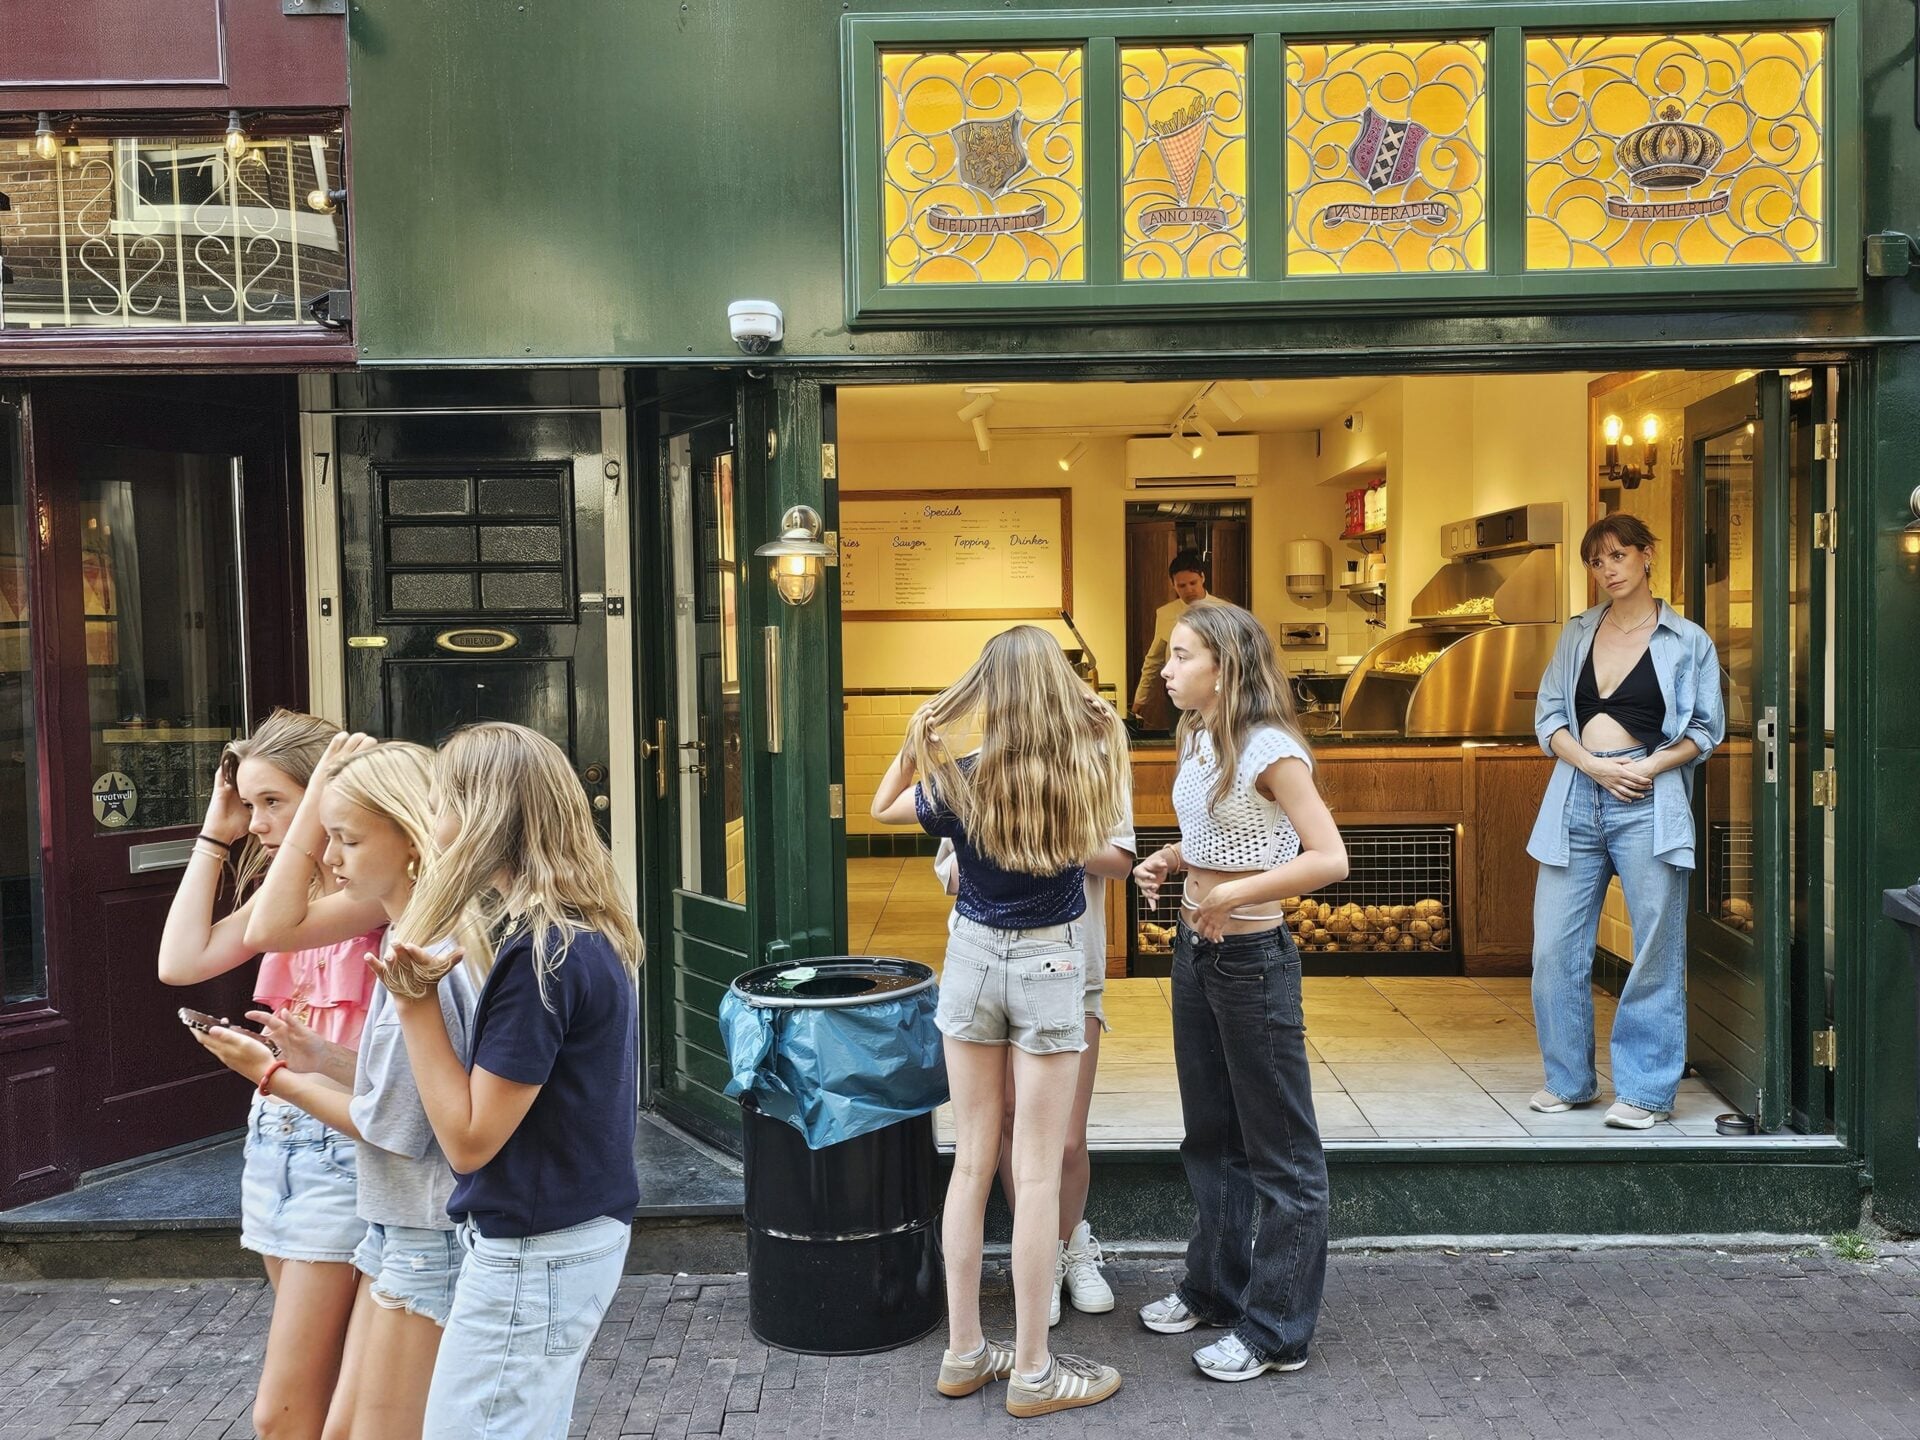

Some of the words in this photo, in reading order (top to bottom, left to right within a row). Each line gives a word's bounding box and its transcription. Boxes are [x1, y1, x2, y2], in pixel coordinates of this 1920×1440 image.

[1334, 202, 1440, 221] VASTBERADEN
[1620, 199, 1725, 218] BARMHARTIG
[1150, 209, 1188, 225] ANNO
[1192, 209, 1217, 222] 1924
[312, 452, 330, 485] 7
[604, 460, 620, 496] 9
[923, 505, 962, 518] Specials
[892, 535, 926, 549] Sauzen
[953, 535, 990, 549] Topping
[1009, 534, 1049, 546] Drinken
[96, 790, 132, 801] treatwell
